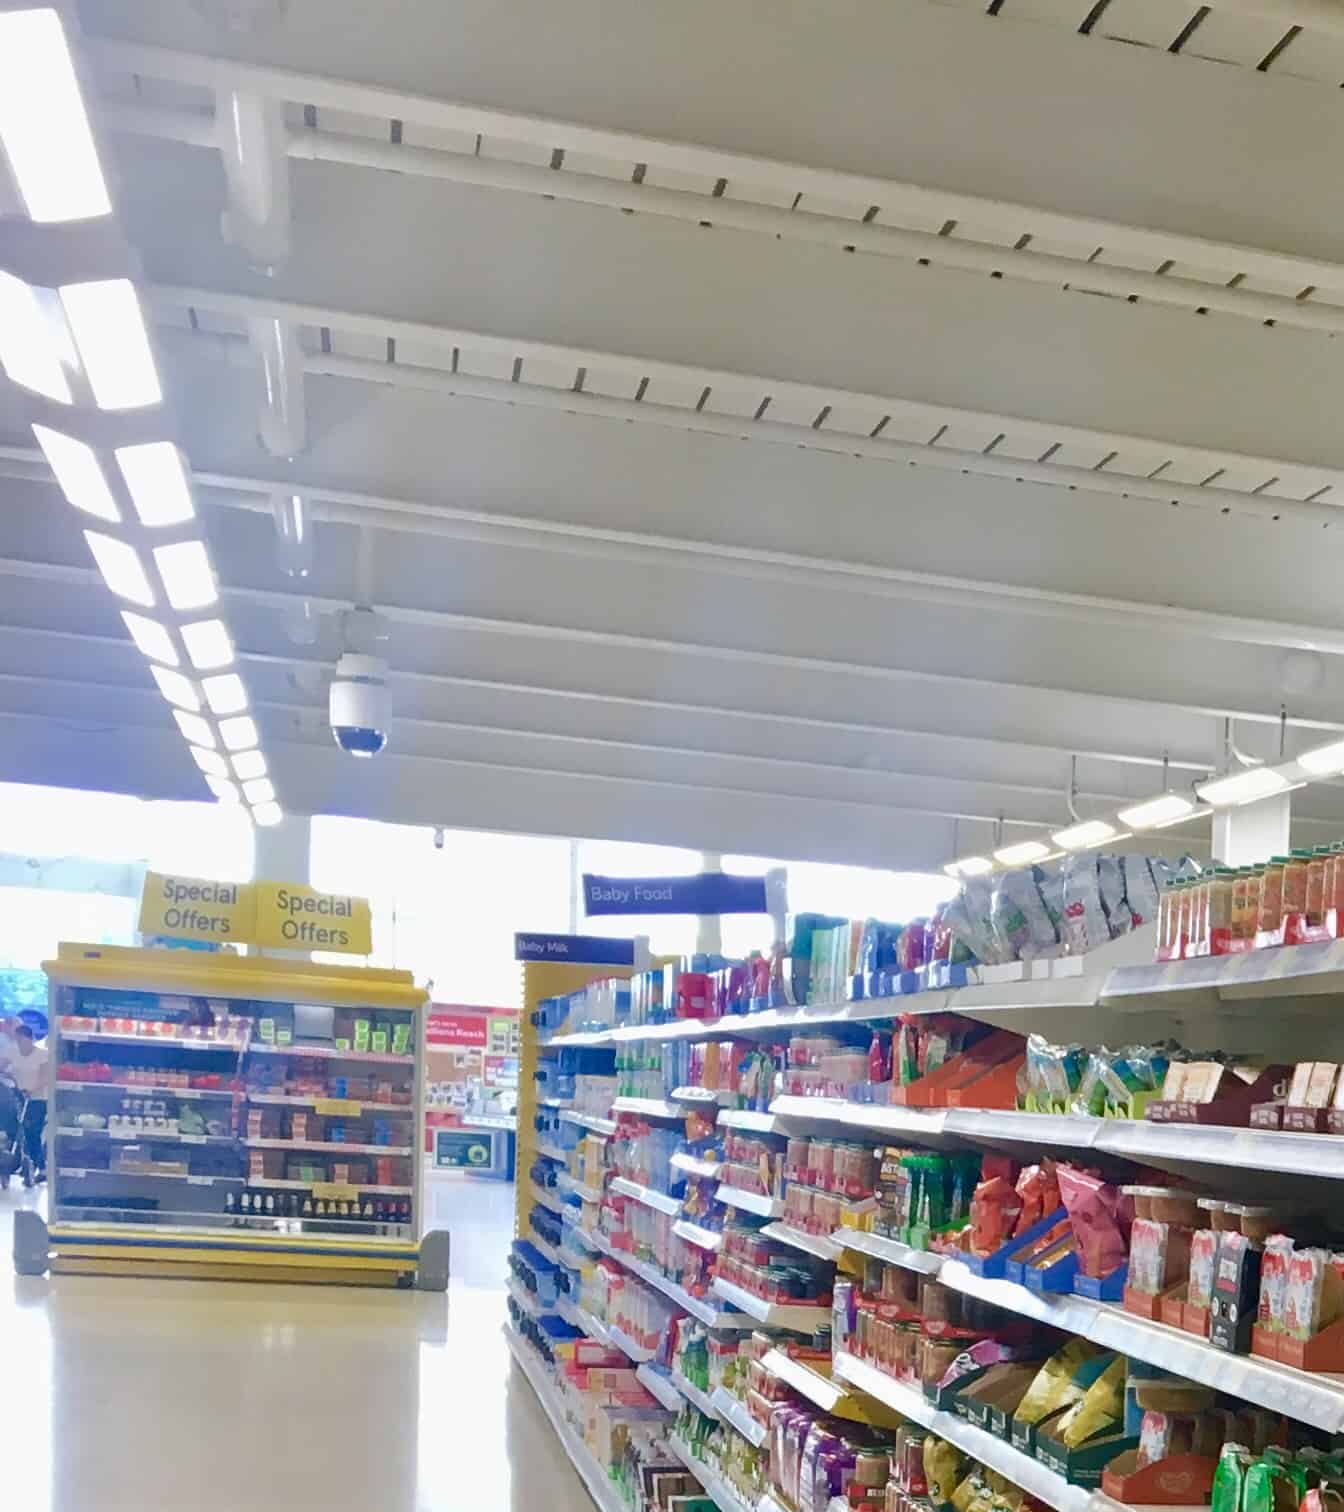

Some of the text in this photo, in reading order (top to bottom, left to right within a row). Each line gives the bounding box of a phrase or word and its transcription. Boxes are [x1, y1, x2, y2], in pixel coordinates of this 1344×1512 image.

[163, 880, 237, 904] Special
[277, 890, 352, 917] Special
[591, 886, 672, 902] Baby Food
[164, 909, 230, 933] Offers
[282, 920, 348, 946] Offers
